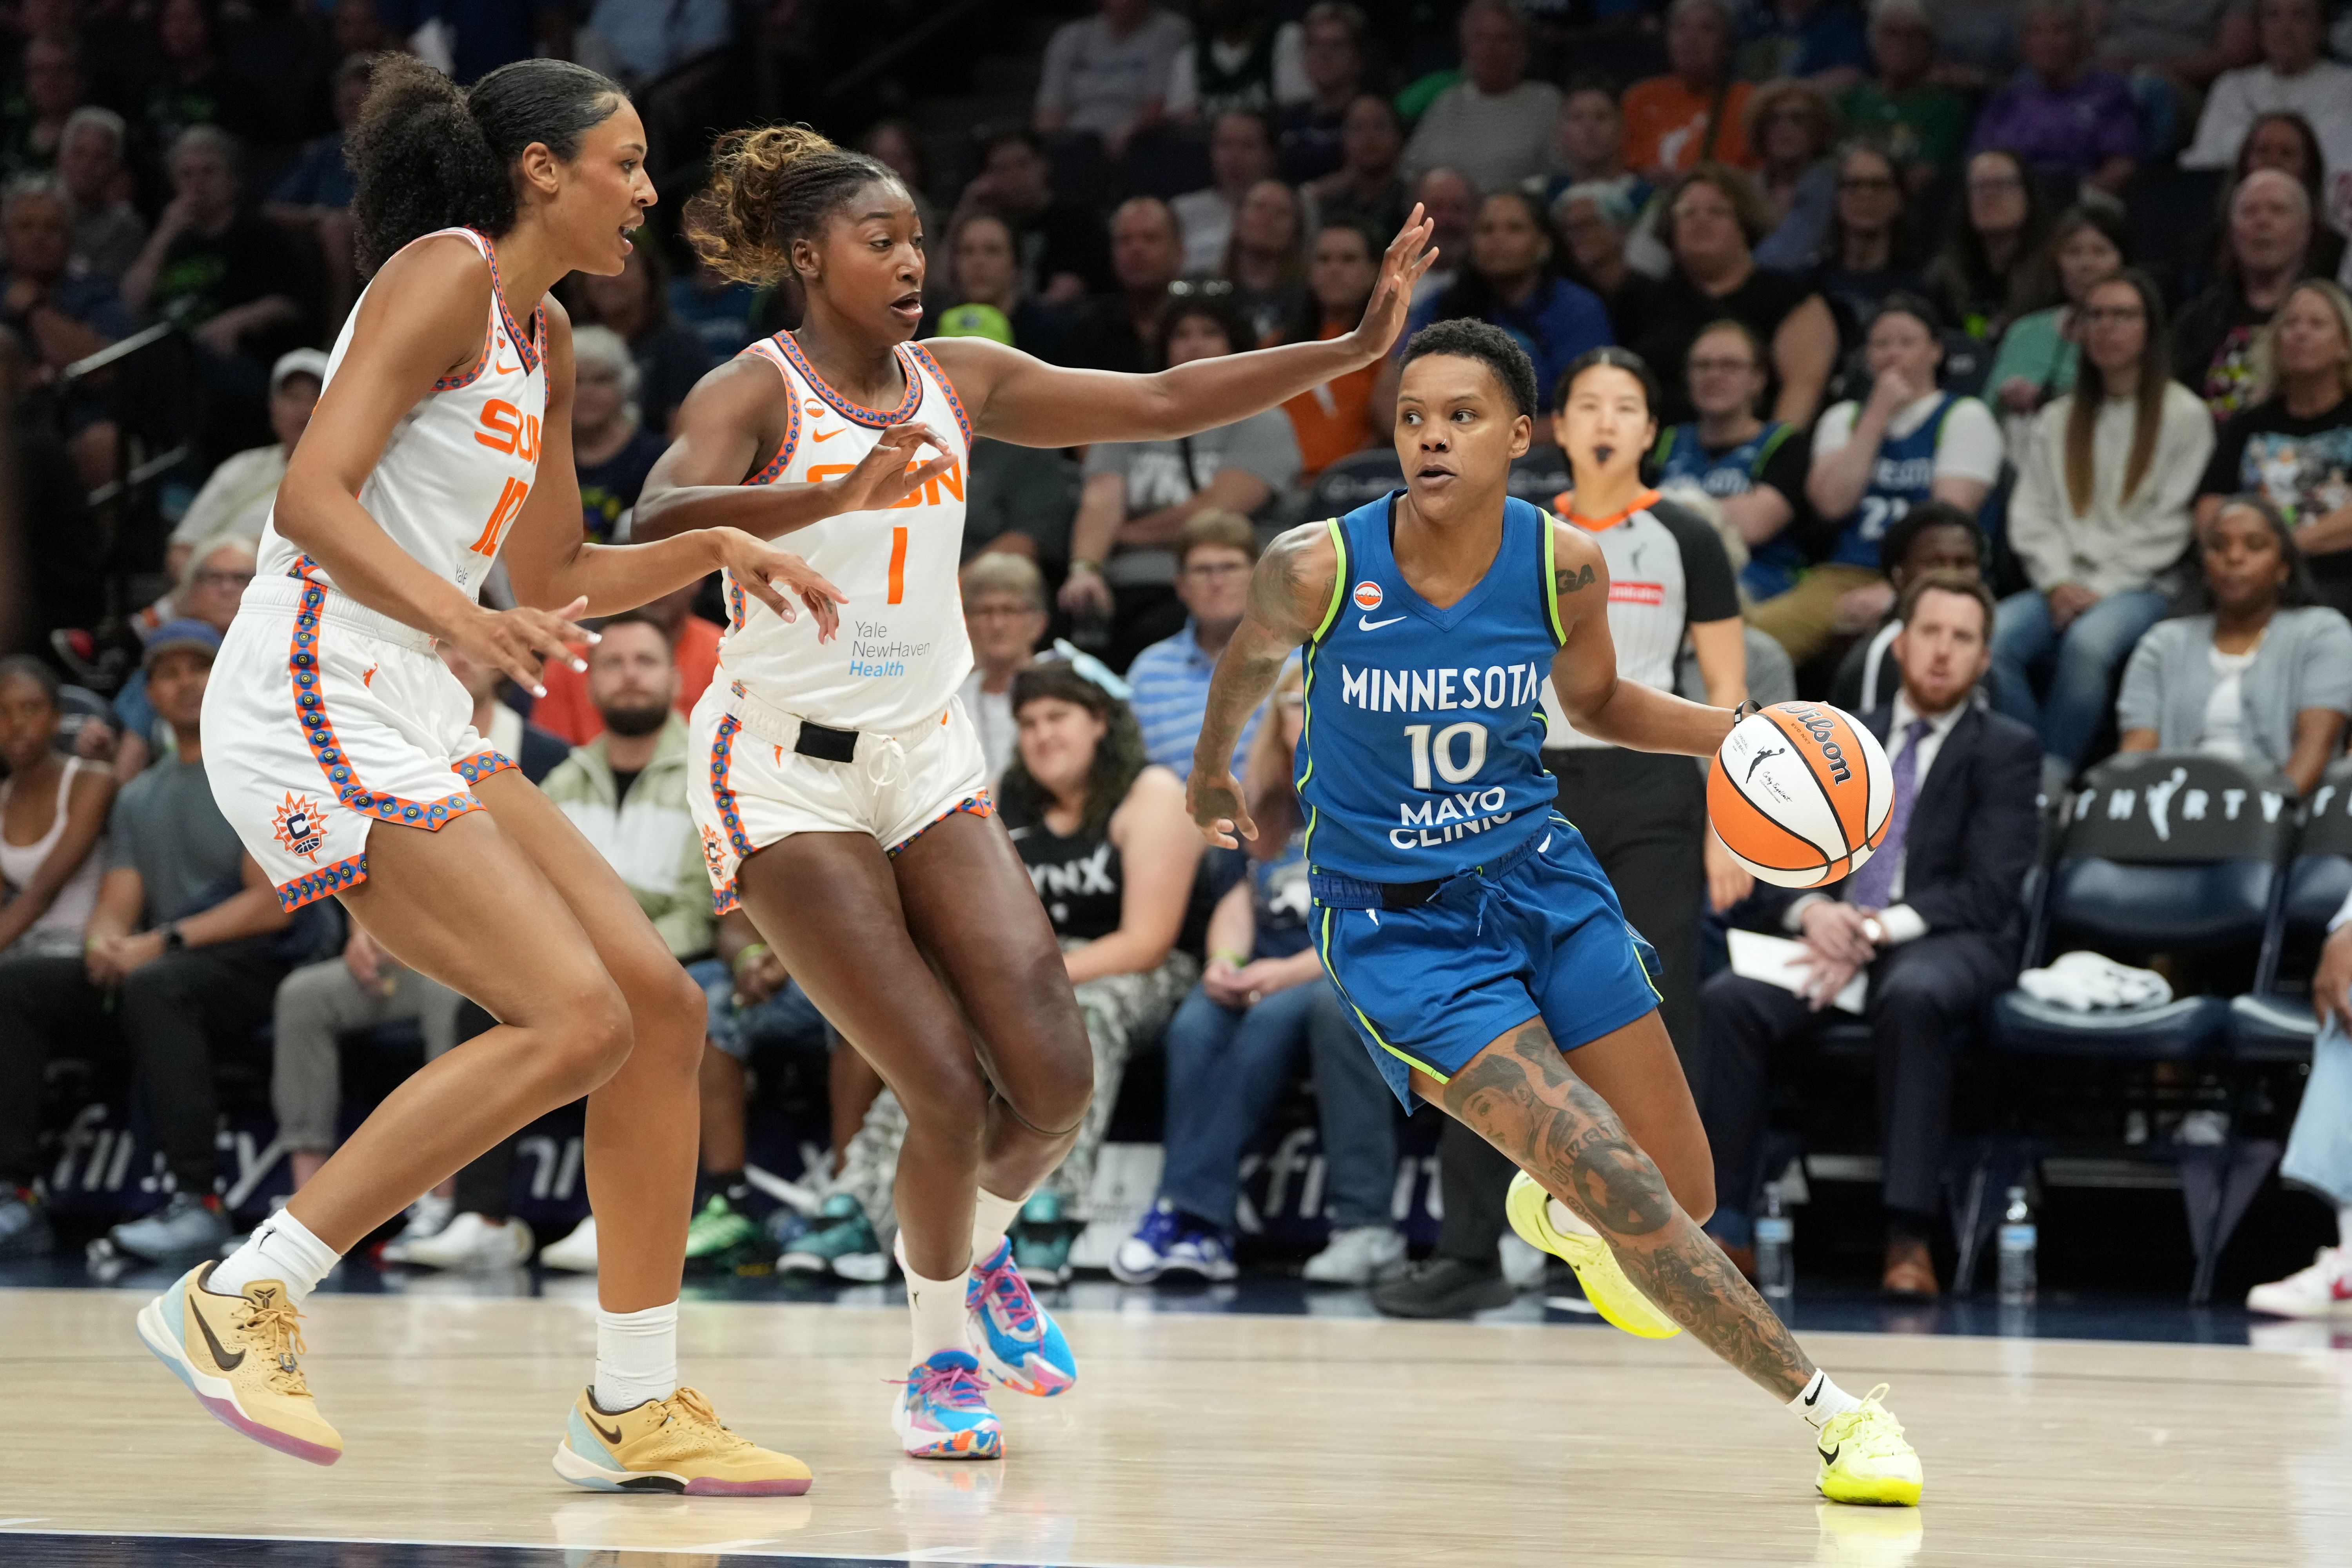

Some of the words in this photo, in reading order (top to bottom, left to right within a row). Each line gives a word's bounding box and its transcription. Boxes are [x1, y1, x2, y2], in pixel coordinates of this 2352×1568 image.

[456, 564, 467, 585] Yale
[887, 526, 907, 604] 1
[855, 621, 887, 638] Yale
[852, 641, 930, 657] NewHaven
[849, 660, 904, 677] Health
[1342, 662, 1537, 712] MINNESOTA
[1738, 733, 1748, 749] OFFICIAL
[1777, 701, 1852, 786] Wilson
[1791, 723, 1801, 733] EVO
[1801, 733, 1811, 745] NXT
[1404, 722, 1488, 789] 10
[1400, 786, 1506, 826] MAYO
